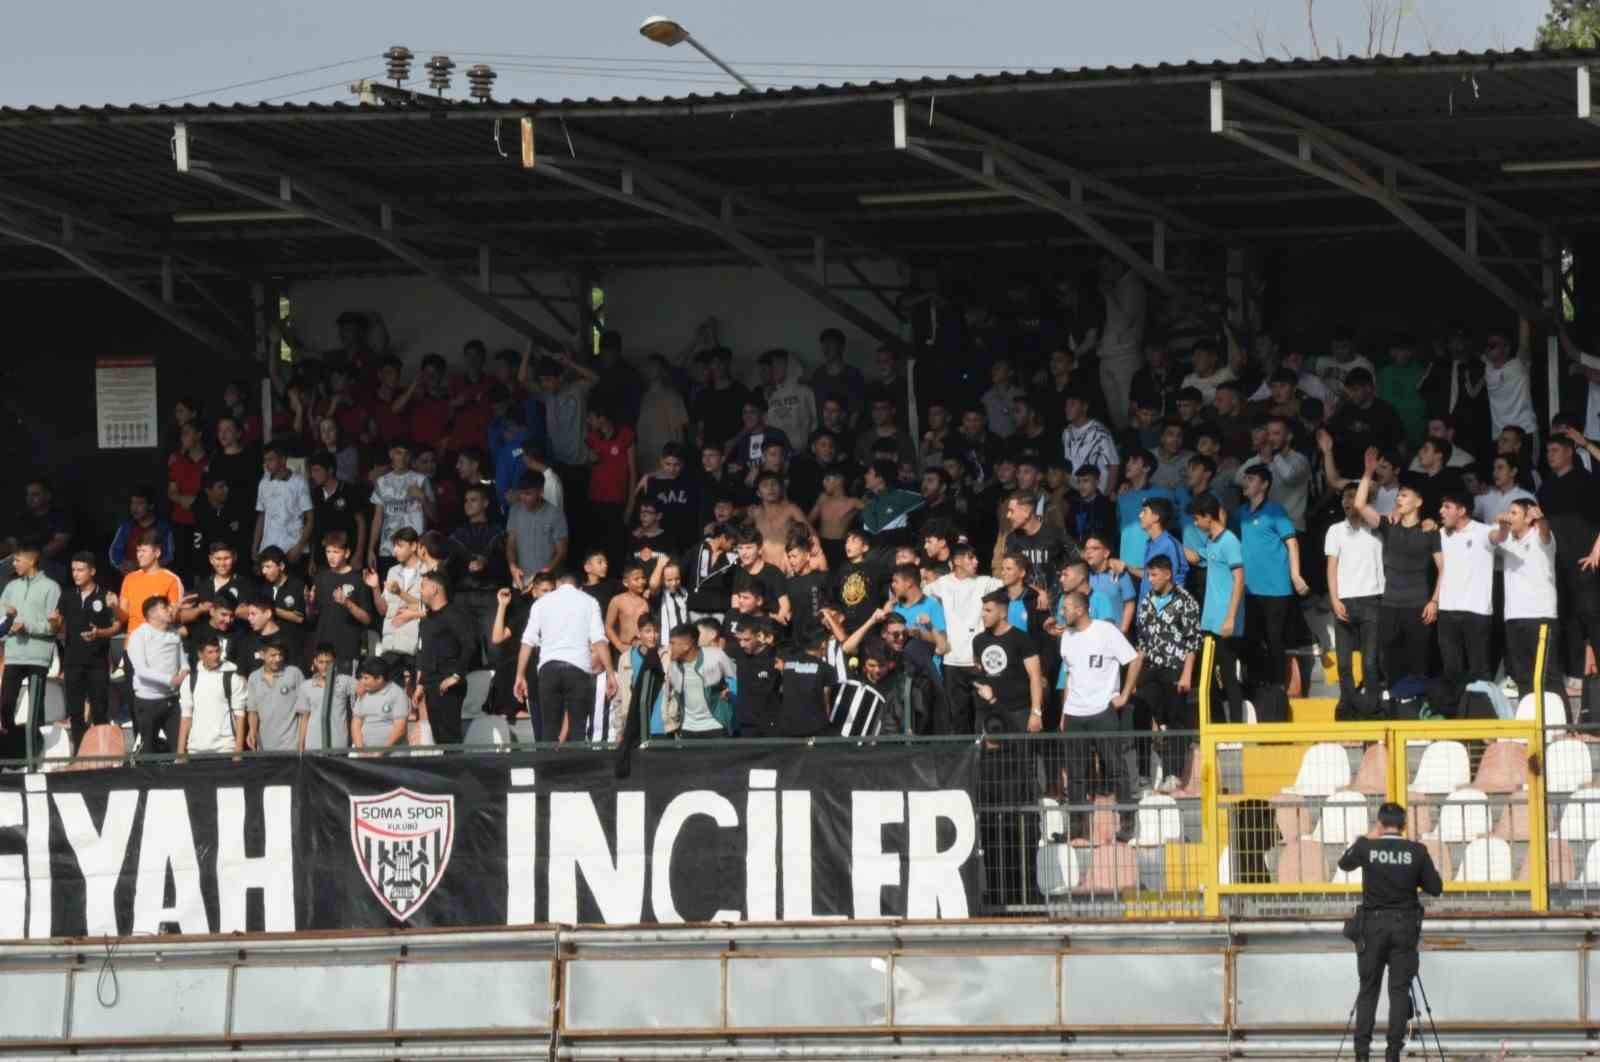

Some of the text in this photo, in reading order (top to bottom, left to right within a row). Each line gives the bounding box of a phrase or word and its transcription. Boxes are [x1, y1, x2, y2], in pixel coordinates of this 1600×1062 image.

[361, 806, 444, 820] SOMA SPOR
[506, 767, 976, 926] İNCİLER
